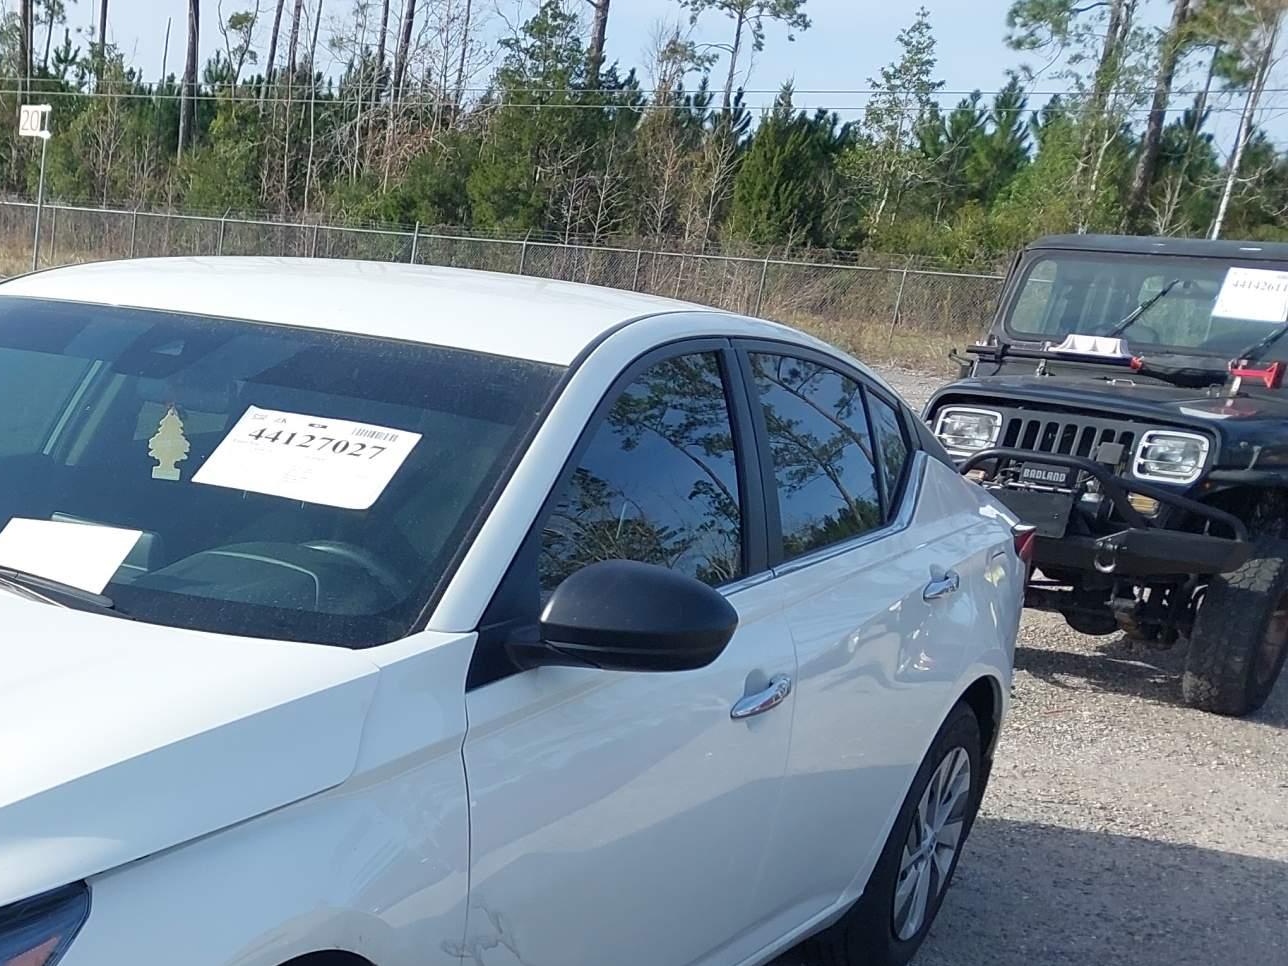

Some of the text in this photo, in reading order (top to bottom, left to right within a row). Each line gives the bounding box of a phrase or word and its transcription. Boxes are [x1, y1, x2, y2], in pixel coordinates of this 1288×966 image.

[21, 109, 40, 131] 20
[248, 427, 387, 460] 44127027
[1023, 468, 1066, 482] BADLAND
